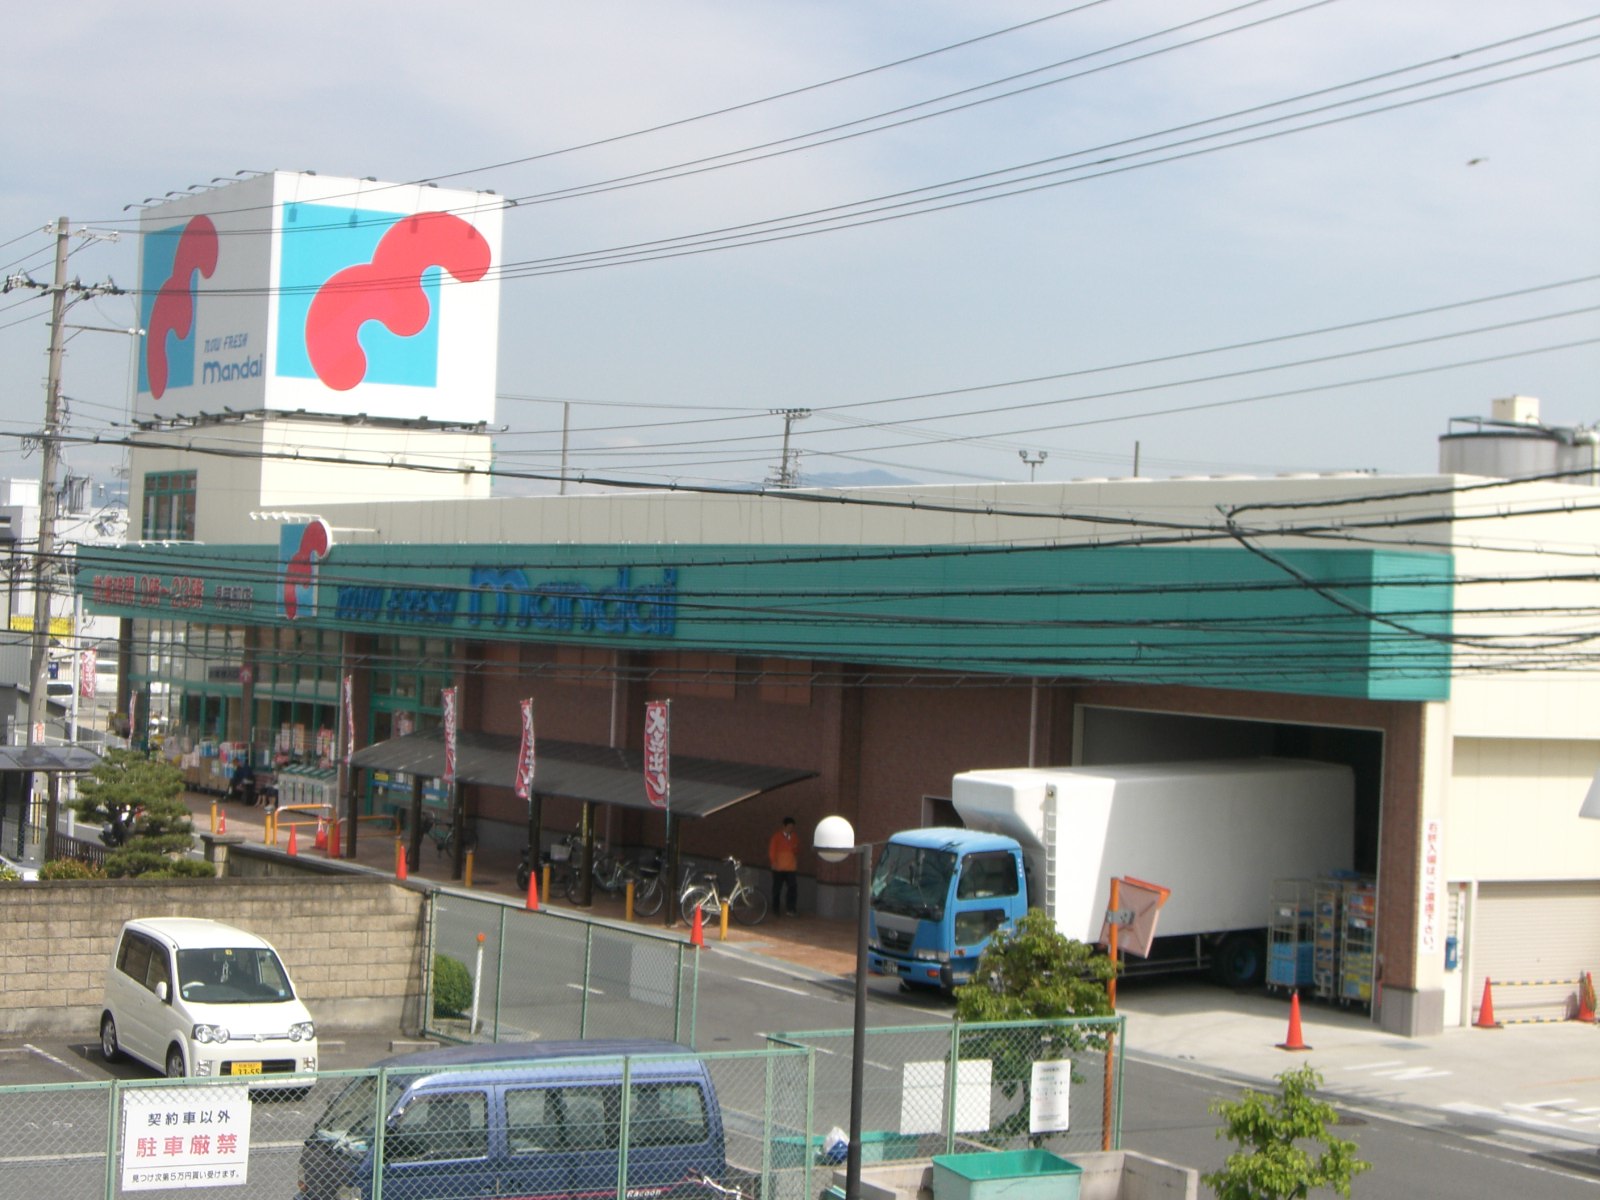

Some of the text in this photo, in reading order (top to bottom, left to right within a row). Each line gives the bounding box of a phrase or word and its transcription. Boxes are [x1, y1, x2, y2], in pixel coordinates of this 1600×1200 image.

[202, 353, 263, 385] mandai
[148, 1110, 230, 1127] 契約車以外
[136, 1133, 237, 1158] 駐車厳禁
